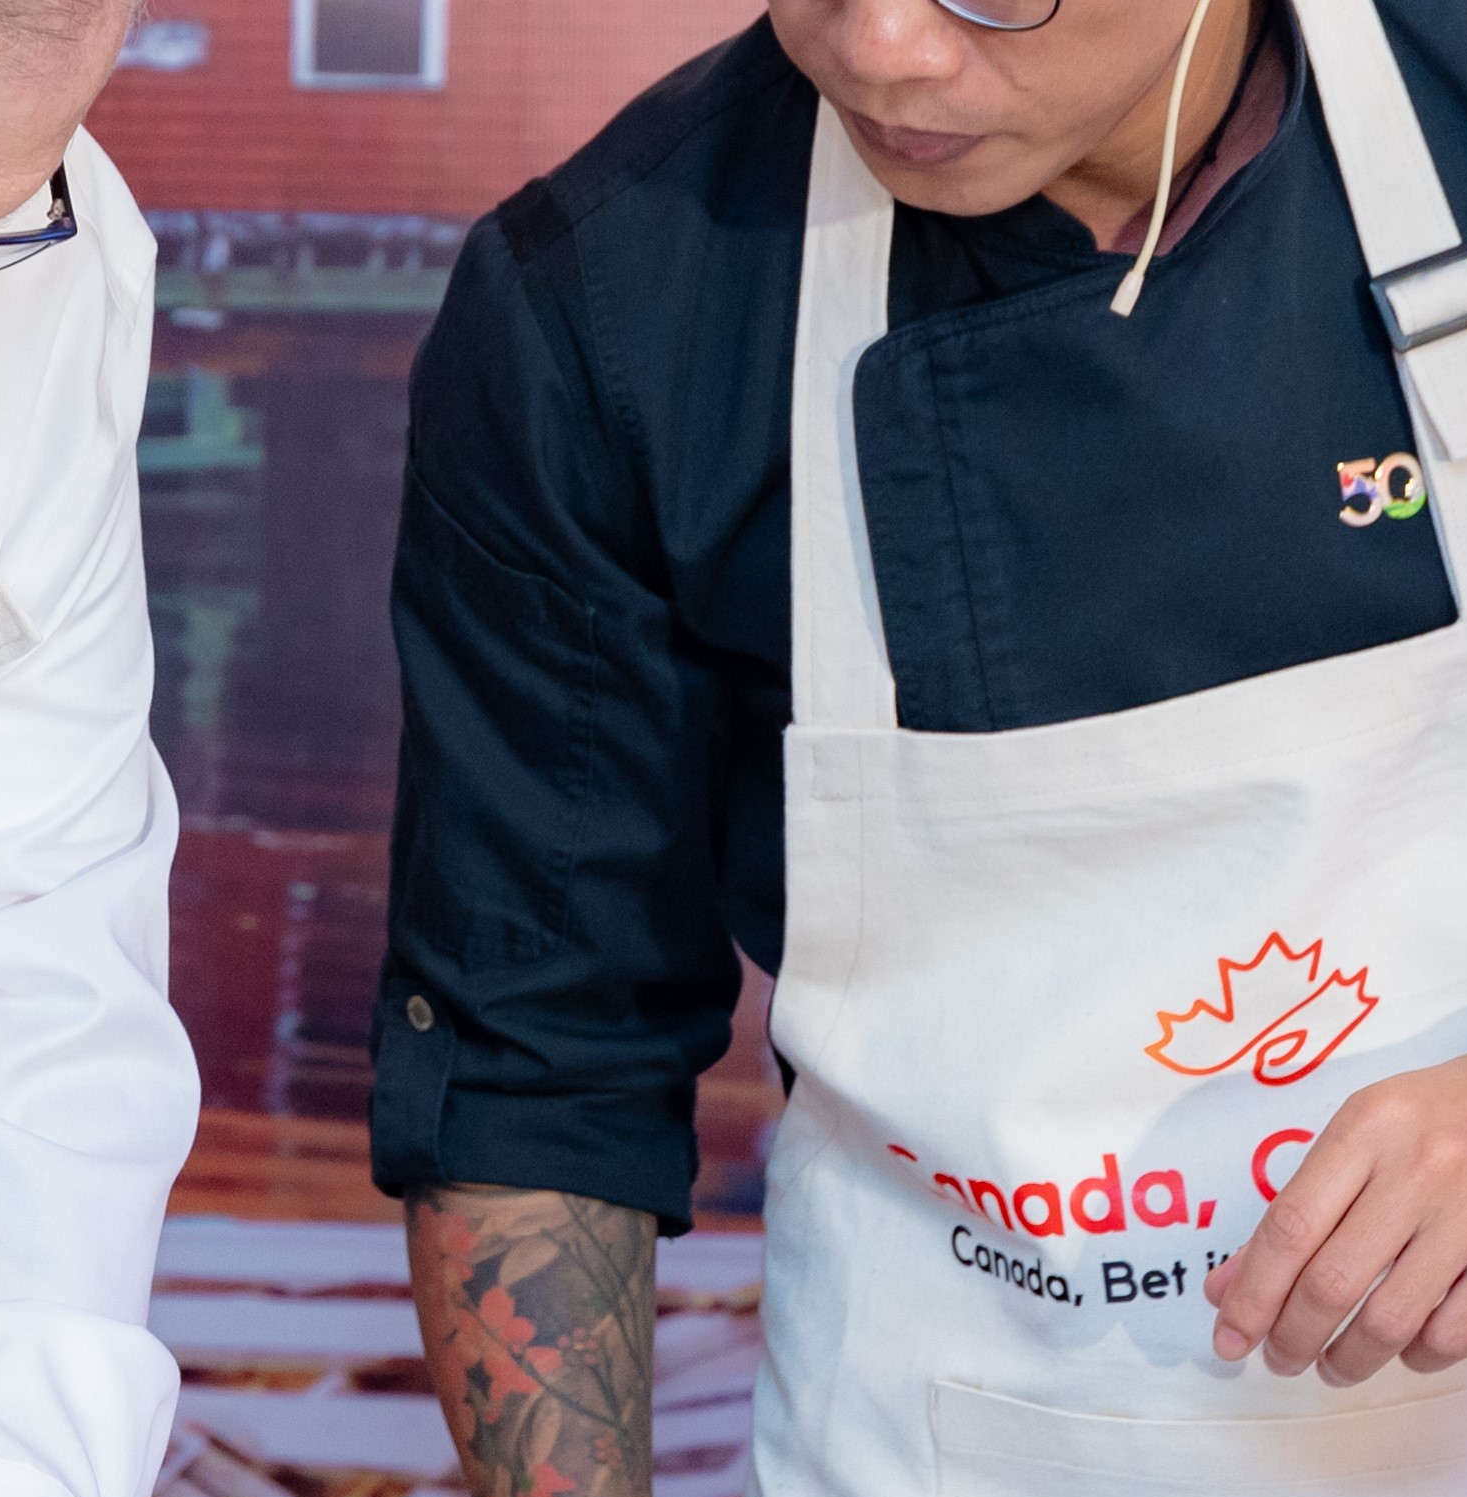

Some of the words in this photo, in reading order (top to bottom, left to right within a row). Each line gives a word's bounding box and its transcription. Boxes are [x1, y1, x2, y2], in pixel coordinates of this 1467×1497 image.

[1337, 452, 1427, 528] 50
[951, 1225, 1083, 1306] Canada,
[1102, 1261, 1187, 1303] Bet
